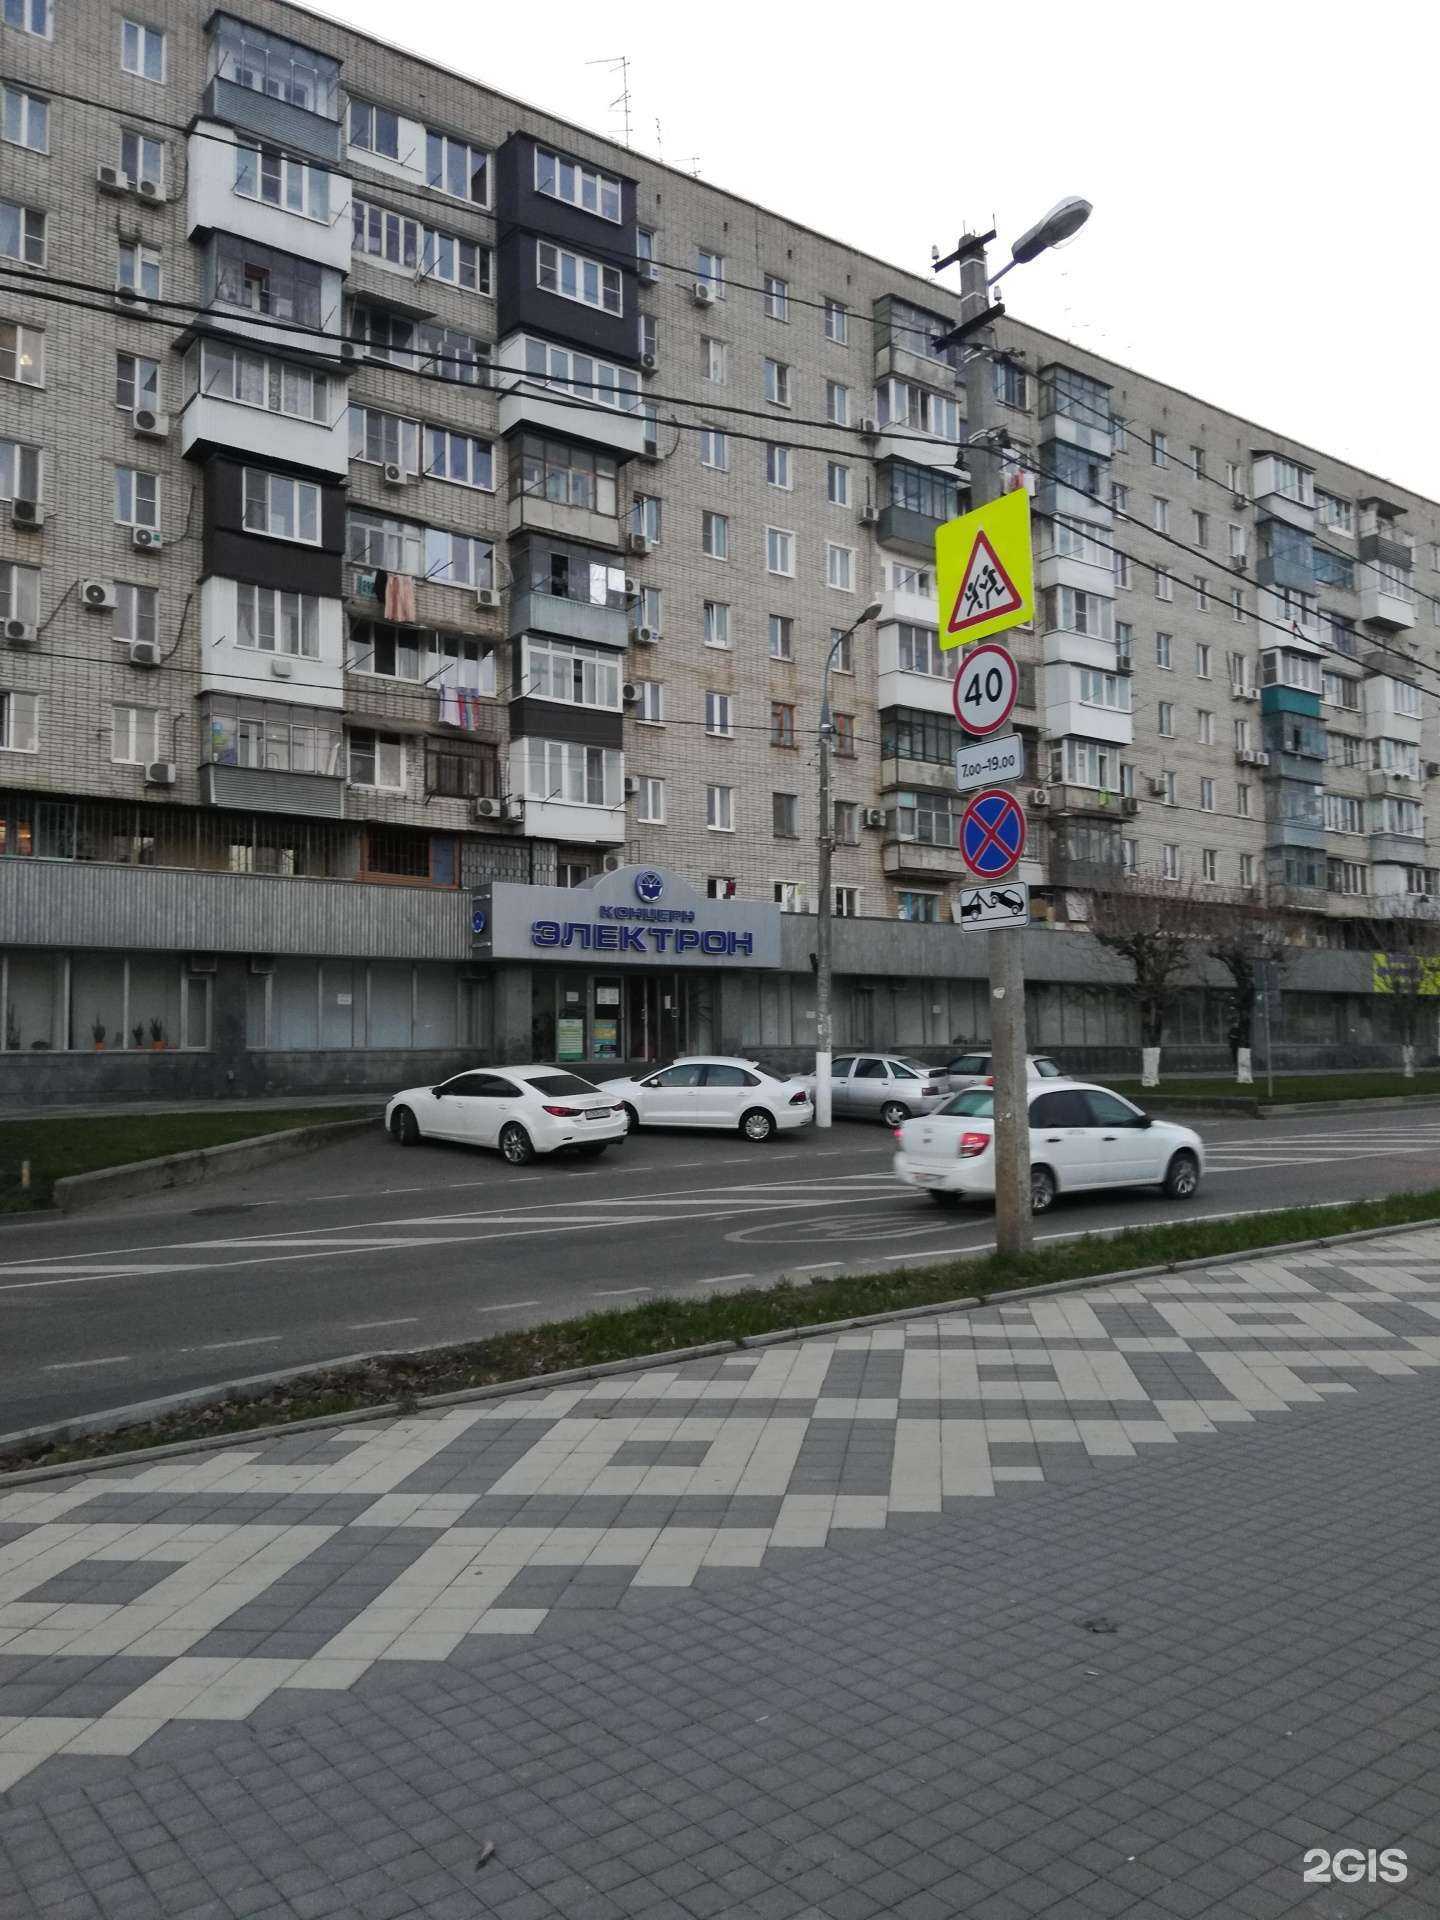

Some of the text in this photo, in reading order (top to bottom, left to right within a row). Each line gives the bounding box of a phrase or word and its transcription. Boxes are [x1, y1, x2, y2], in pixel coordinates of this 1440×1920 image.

[965, 668, 1003, 706] 40
[599, 905, 696, 924] КОНЦЕРН
[531, 920, 753, 956] ЭЛЕКТРОН
